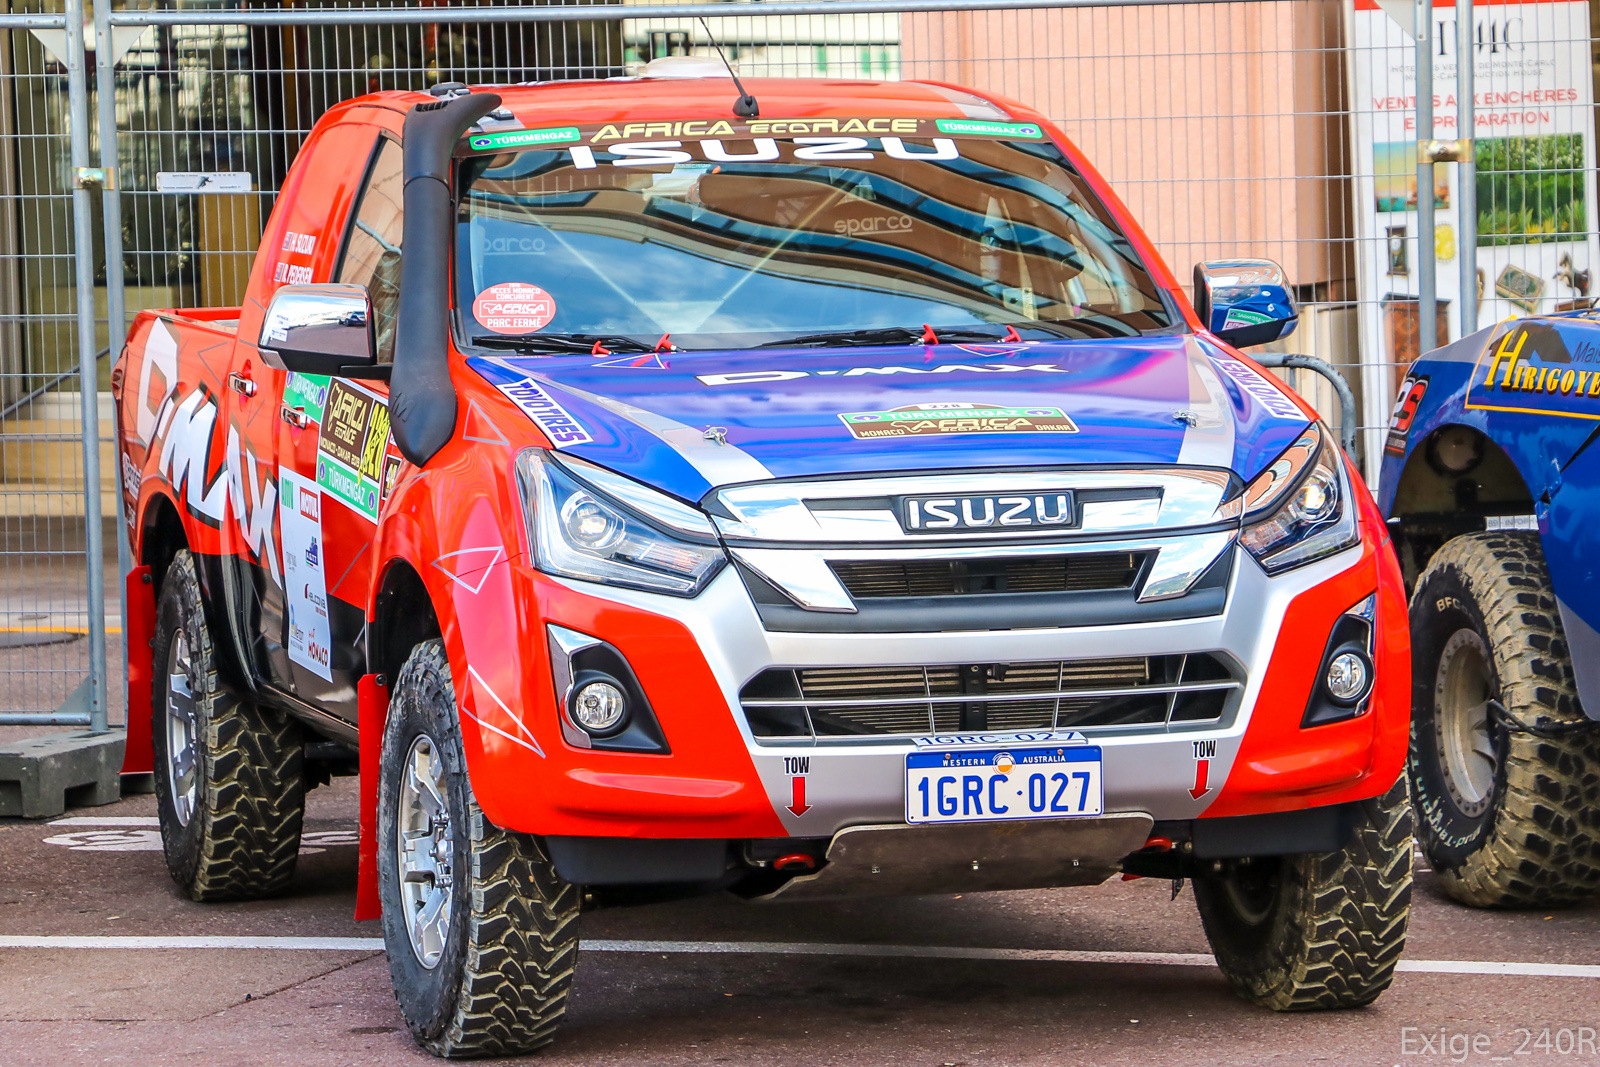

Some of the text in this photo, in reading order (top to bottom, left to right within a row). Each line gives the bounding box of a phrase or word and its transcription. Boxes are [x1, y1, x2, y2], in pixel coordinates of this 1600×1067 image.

[1373, 94, 1442, 110] VENTS
[1484, 86, 1578, 105] ENCHÈRES
[494, 130, 573, 145] TÜRKMENGAZ
[590, 119, 735, 143] AFRICA
[943, 122, 1018, 135] TÜRKMENGAZ
[568, 136, 960, 170] ISUZU
[834, 214, 913, 237] sparco
[484, 237, 546, 252] parco
[491, 303, 546, 313] AFRICA
[487, 317, 542, 328] PARC FERMÉ
[695, 364, 1069, 386] D-MAX
[331, 389, 368, 432] AFRICA
[886, 408, 1022, 420] TÜRKMENGAZ
[860, 417, 1072, 438] MONACO AFRICA DAKAR
[908, 495, 1068, 529] ISUZU
[308, 641, 329, 667] MONACO
[1192, 739, 1217, 758] TOW
[783, 756, 810, 774] TOW
[942, 754, 1066, 767] WESTERN AUSTRALIA
